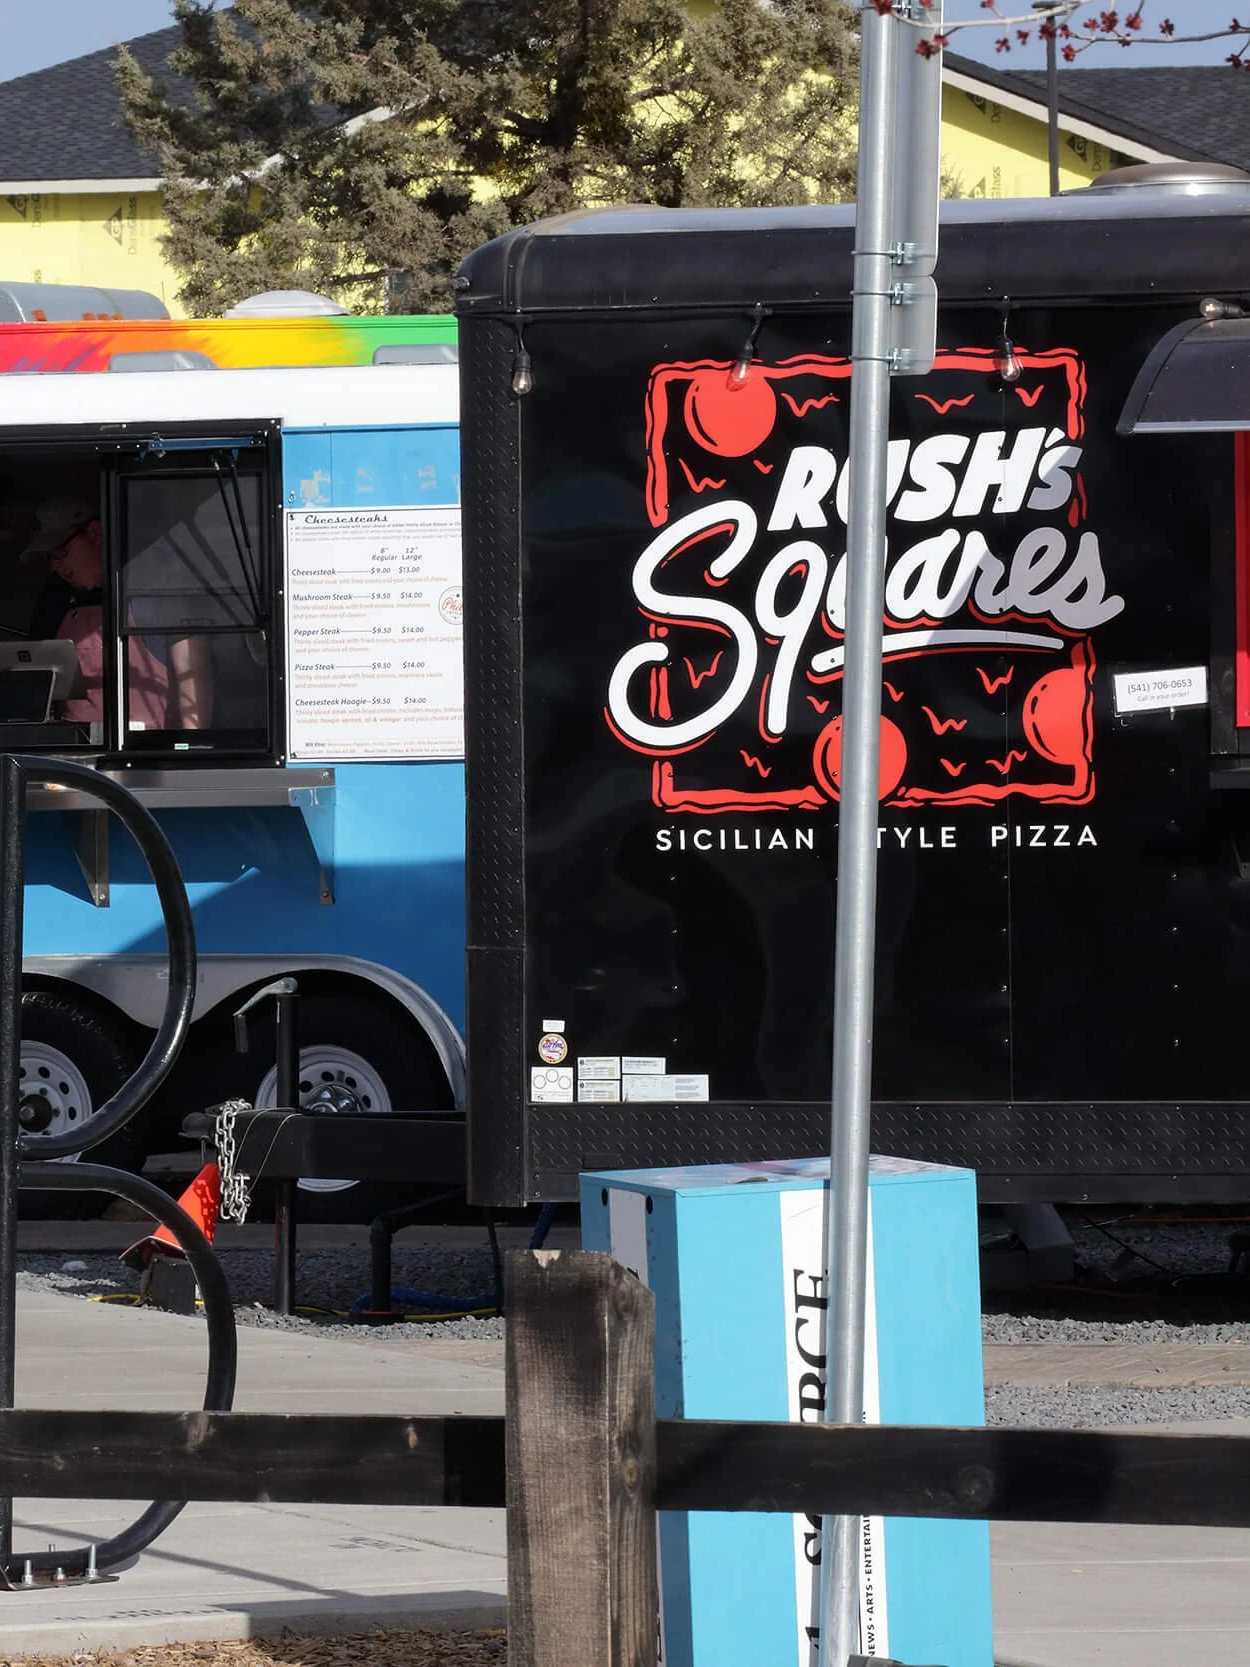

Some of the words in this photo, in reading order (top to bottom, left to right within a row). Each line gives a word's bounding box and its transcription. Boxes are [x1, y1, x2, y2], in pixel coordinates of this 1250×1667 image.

[305, 514, 388, 525] Cheesesteaks
[372, 554, 398, 562] Regular
[401, 553, 423, 562] Large
[292, 568, 336, 576] Cheesesteak
[293, 593, 331, 601] Mushroom
[293, 629, 319, 637] Pepper
[320, 627, 341, 635] Steak
[295, 663, 313, 671] Pizza
[1128, 683, 1151, 694] (541)
[1152, 679, 1193, 690] 706-0653
[295, 698, 339, 706] Cheesesteak
[340, 697, 367, 706] Hoagie
[655, 825, 815, 851] SICILIAN
[877, 826, 957, 849] TYLE
[991, 824, 1098, 847] PIZZA
[862, 1514, 873, 1575] ENTERTAI
[865, 1584, 875, 1614] ARTS
